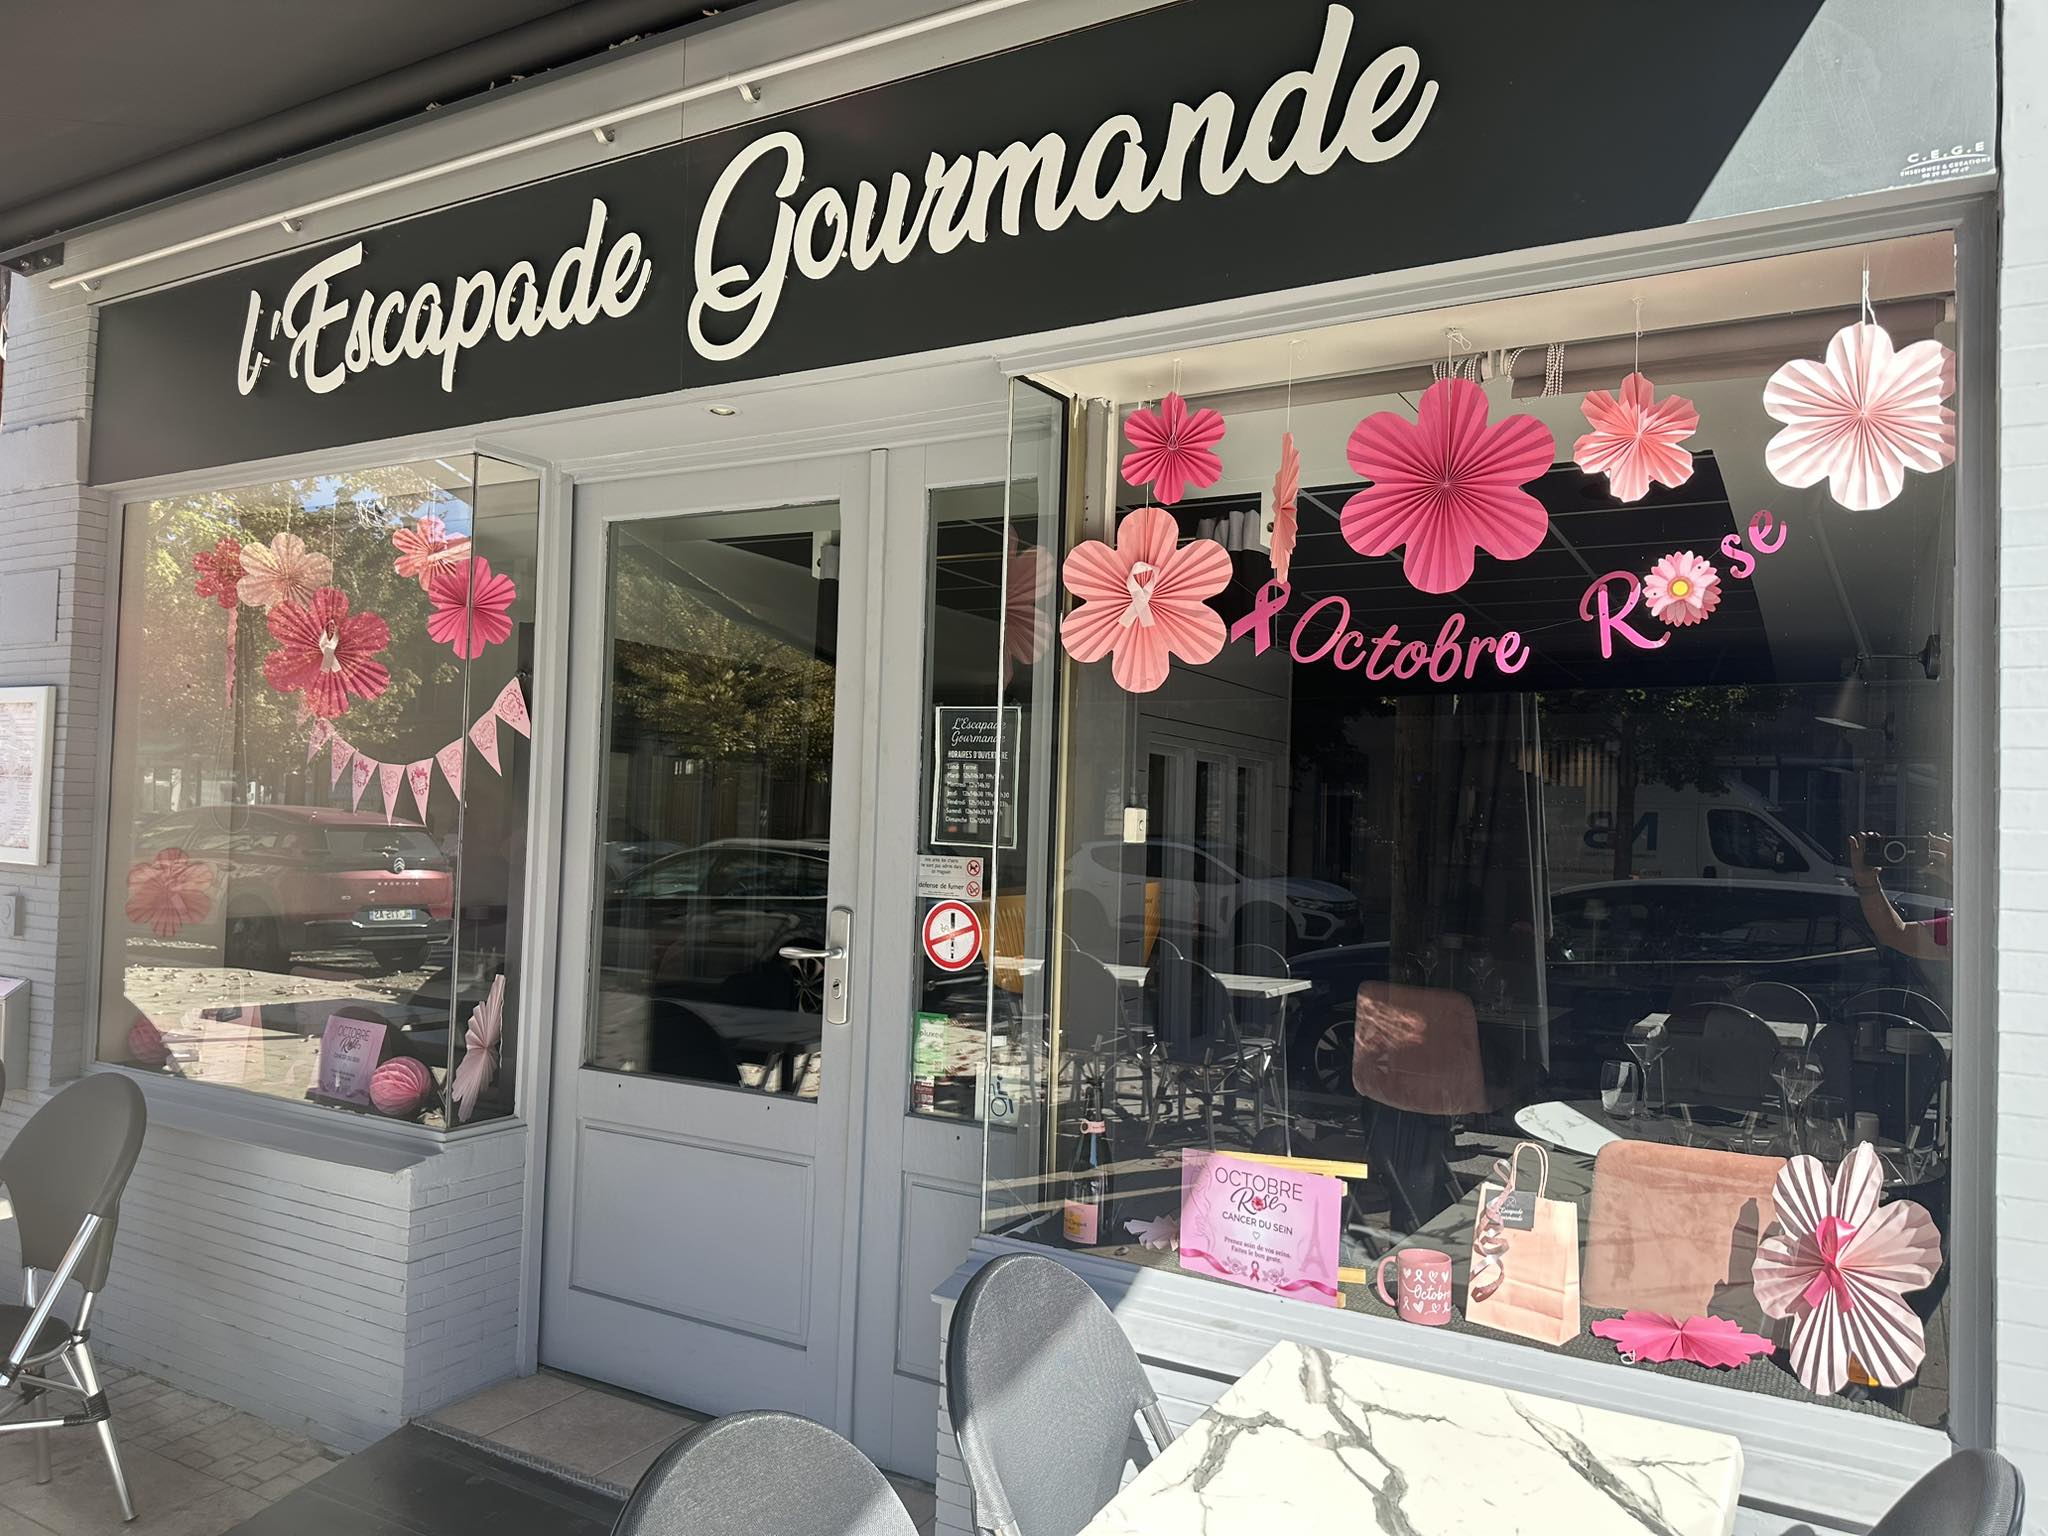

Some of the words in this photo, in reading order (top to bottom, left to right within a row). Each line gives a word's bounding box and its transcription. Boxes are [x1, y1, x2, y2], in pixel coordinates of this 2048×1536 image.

[237, 198, 652, 395] l'Escapade
[687, 3, 1440, 361] Gourmande
[1289, 595, 1530, 682] Octobre
[948, 750, 972, 759] HORAIRES
[973, 751, 1008, 760] D'OUVERTRE
[1215, 1167, 1303, 1201] OCTOBRE
[1222, 1211, 1257, 1226] CANCER
[1259, 1219, 1272, 1230] DU
[1273, 1223, 1293, 1236] SEIN
[1224, 1235, 1243, 1246] Prenez
[1243, 1240, 1256, 1249] soin
[1256, 1242, 1264, 1250] de
[1231, 1245, 1248, 1256] Faites
[1248, 1248, 1254, 1257] le
[1254, 1250, 1265, 1259] bon
[1409, 1283, 1450, 1300] Octobr
